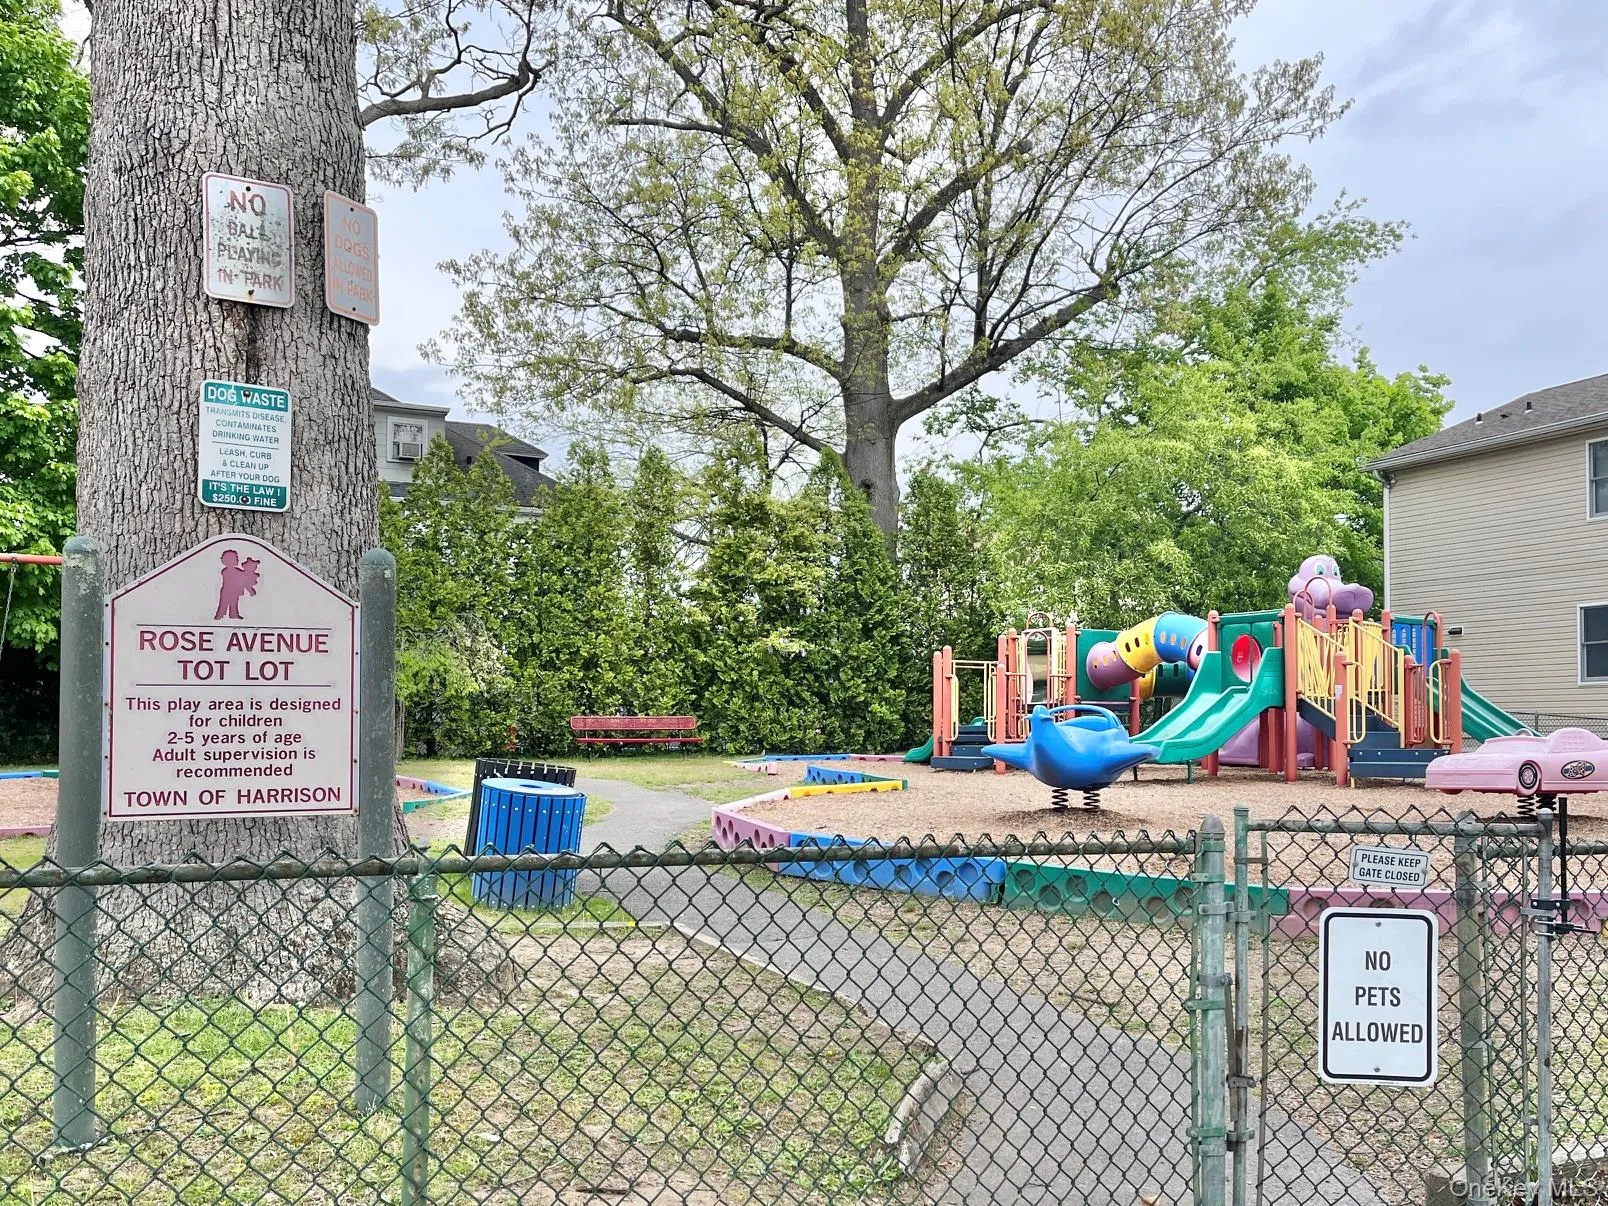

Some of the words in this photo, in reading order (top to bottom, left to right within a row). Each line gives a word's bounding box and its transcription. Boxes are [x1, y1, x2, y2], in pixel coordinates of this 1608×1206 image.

[230, 190, 267, 216] NO
[343, 216, 361, 235] NO
[335, 234, 369, 260] DOGS
[244, 271, 282, 291] PARK
[207, 386, 237, 402] DOG
[240, 390, 285, 408] WASTE
[206, 407, 251, 419] TRANSMITS
[215, 419, 277, 432] CONTAMINATES
[212, 430, 251, 441] DRINKING
[253, 434, 280, 444] WATER
[249, 451, 272, 460] CURB
[229, 460, 256, 469] CLEAN
[210, 470, 236, 479] AFTER
[238, 472, 260, 481] YOUR
[262, 475, 280, 483] DOG
[209, 482, 227, 491] IT'S
[230, 484, 250, 493] THE
[254, 497, 277, 507] FINE
[139, 630, 214, 652] ROSE
[226, 632, 329, 653] AVENUE
[177, 660, 230, 681] TOT
[245, 661, 294, 681] LOT
[125, 697, 161, 711] This
[167, 697, 200, 713] play
[208, 699, 244, 711] area
[250, 697, 263, 711] is
[269, 697, 341, 713] designed
[189, 714, 211, 727] for
[219, 714, 283, 727] children
[167, 731, 194, 744] 2-5
[201, 733, 246, 746] years
[252, 731, 268, 744] of
[274, 733, 302, 746] age
[152, 748, 196, 762] Adult
[203, 747, 298, 763] supervision
[303, 747, 316, 760] is
[176, 764, 293, 778] recommended
[124, 790, 187, 807] TOWN
[199, 789, 226, 805] OF
[237, 787, 341, 804] HARRISON
[1361, 853, 1396, 866] PLEASE
[1398, 856, 1421, 868] KEEP
[1359, 867, 1382, 879] GATE
[1384, 869, 1420, 882] CLOSED
[1365, 950, 1391, 971] NO
[1355, 986, 1401, 1007] PETS
[1331, 1021, 1423, 1044] ALLOWED
